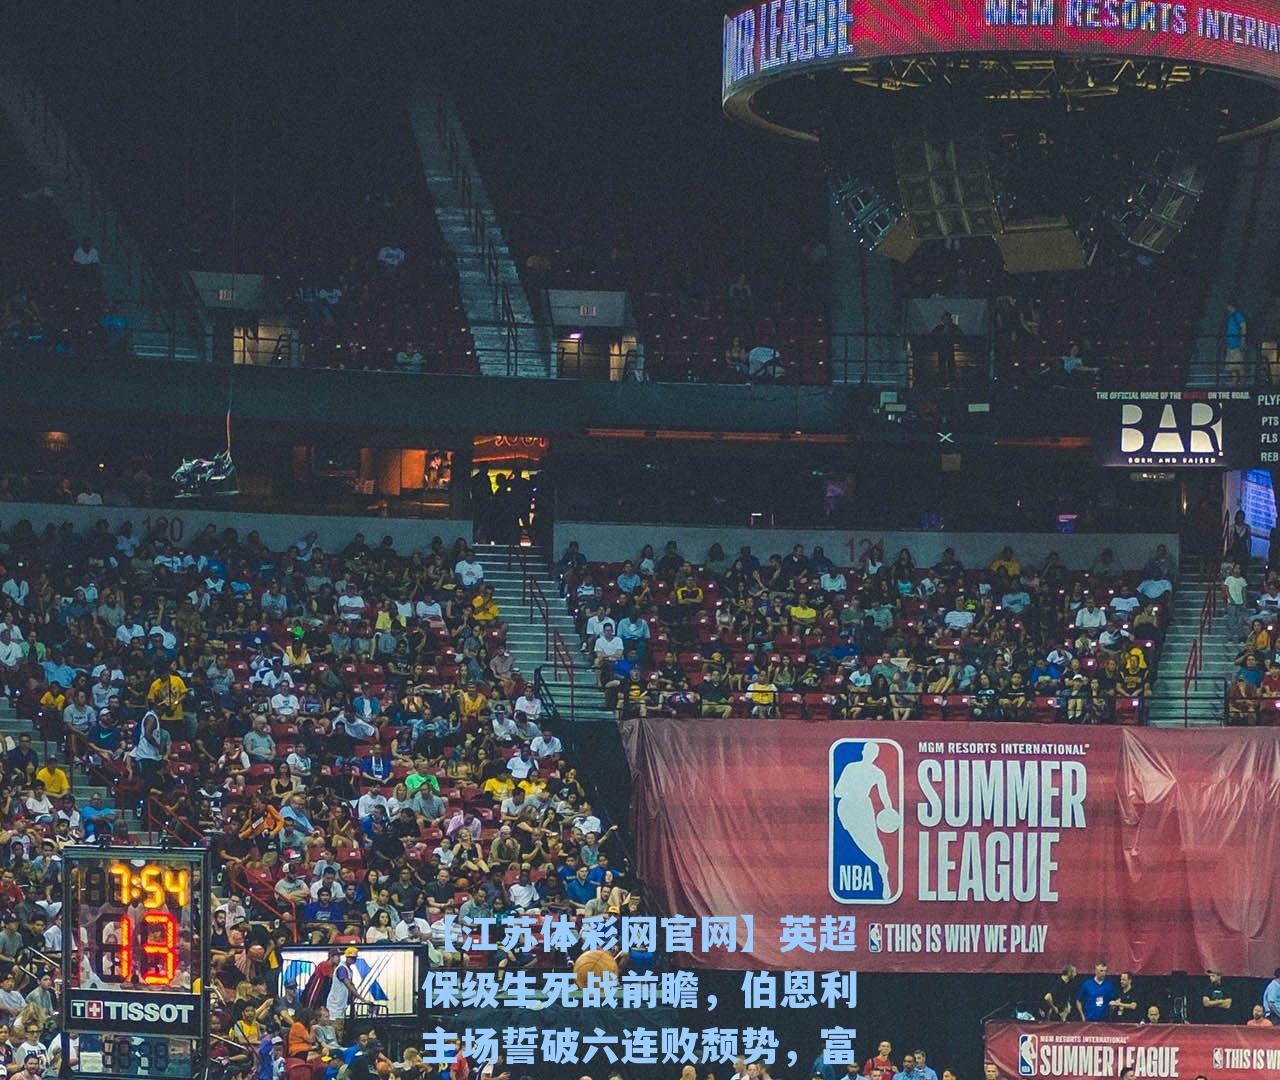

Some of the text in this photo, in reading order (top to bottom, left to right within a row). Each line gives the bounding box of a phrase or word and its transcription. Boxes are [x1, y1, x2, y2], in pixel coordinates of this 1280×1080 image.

[985, 0, 1054, 25] MGM
[1066, 0, 1187, 35] RESORTS
[760, 0, 853, 70] LEAGUE
[1261, 416, 1279, 426] PTS
[1261, 433, 1278, 443] FLS
[1260, 452, 1279, 462] REB
[918, 743, 1089, 755] MGM RESORTS INTERNATIONAL
[918, 759, 1087, 829] SUMMER
[838, 864, 874, 892] NBA
[918, 830, 1060, 902] LEAGUE
[109, 862, 191, 909] 7:54
[119, 912, 179, 986] 13
[885, 923, 1048, 954] THIS IS WHY WE PLAY
[105, 1001, 195, 1023] TISSOT
[1039, 1046, 1179, 1078] SUMMER LEAGUE
[1224, 1048, 1253, 1071] THIS
[1255, 1049, 1265, 1071] IS
